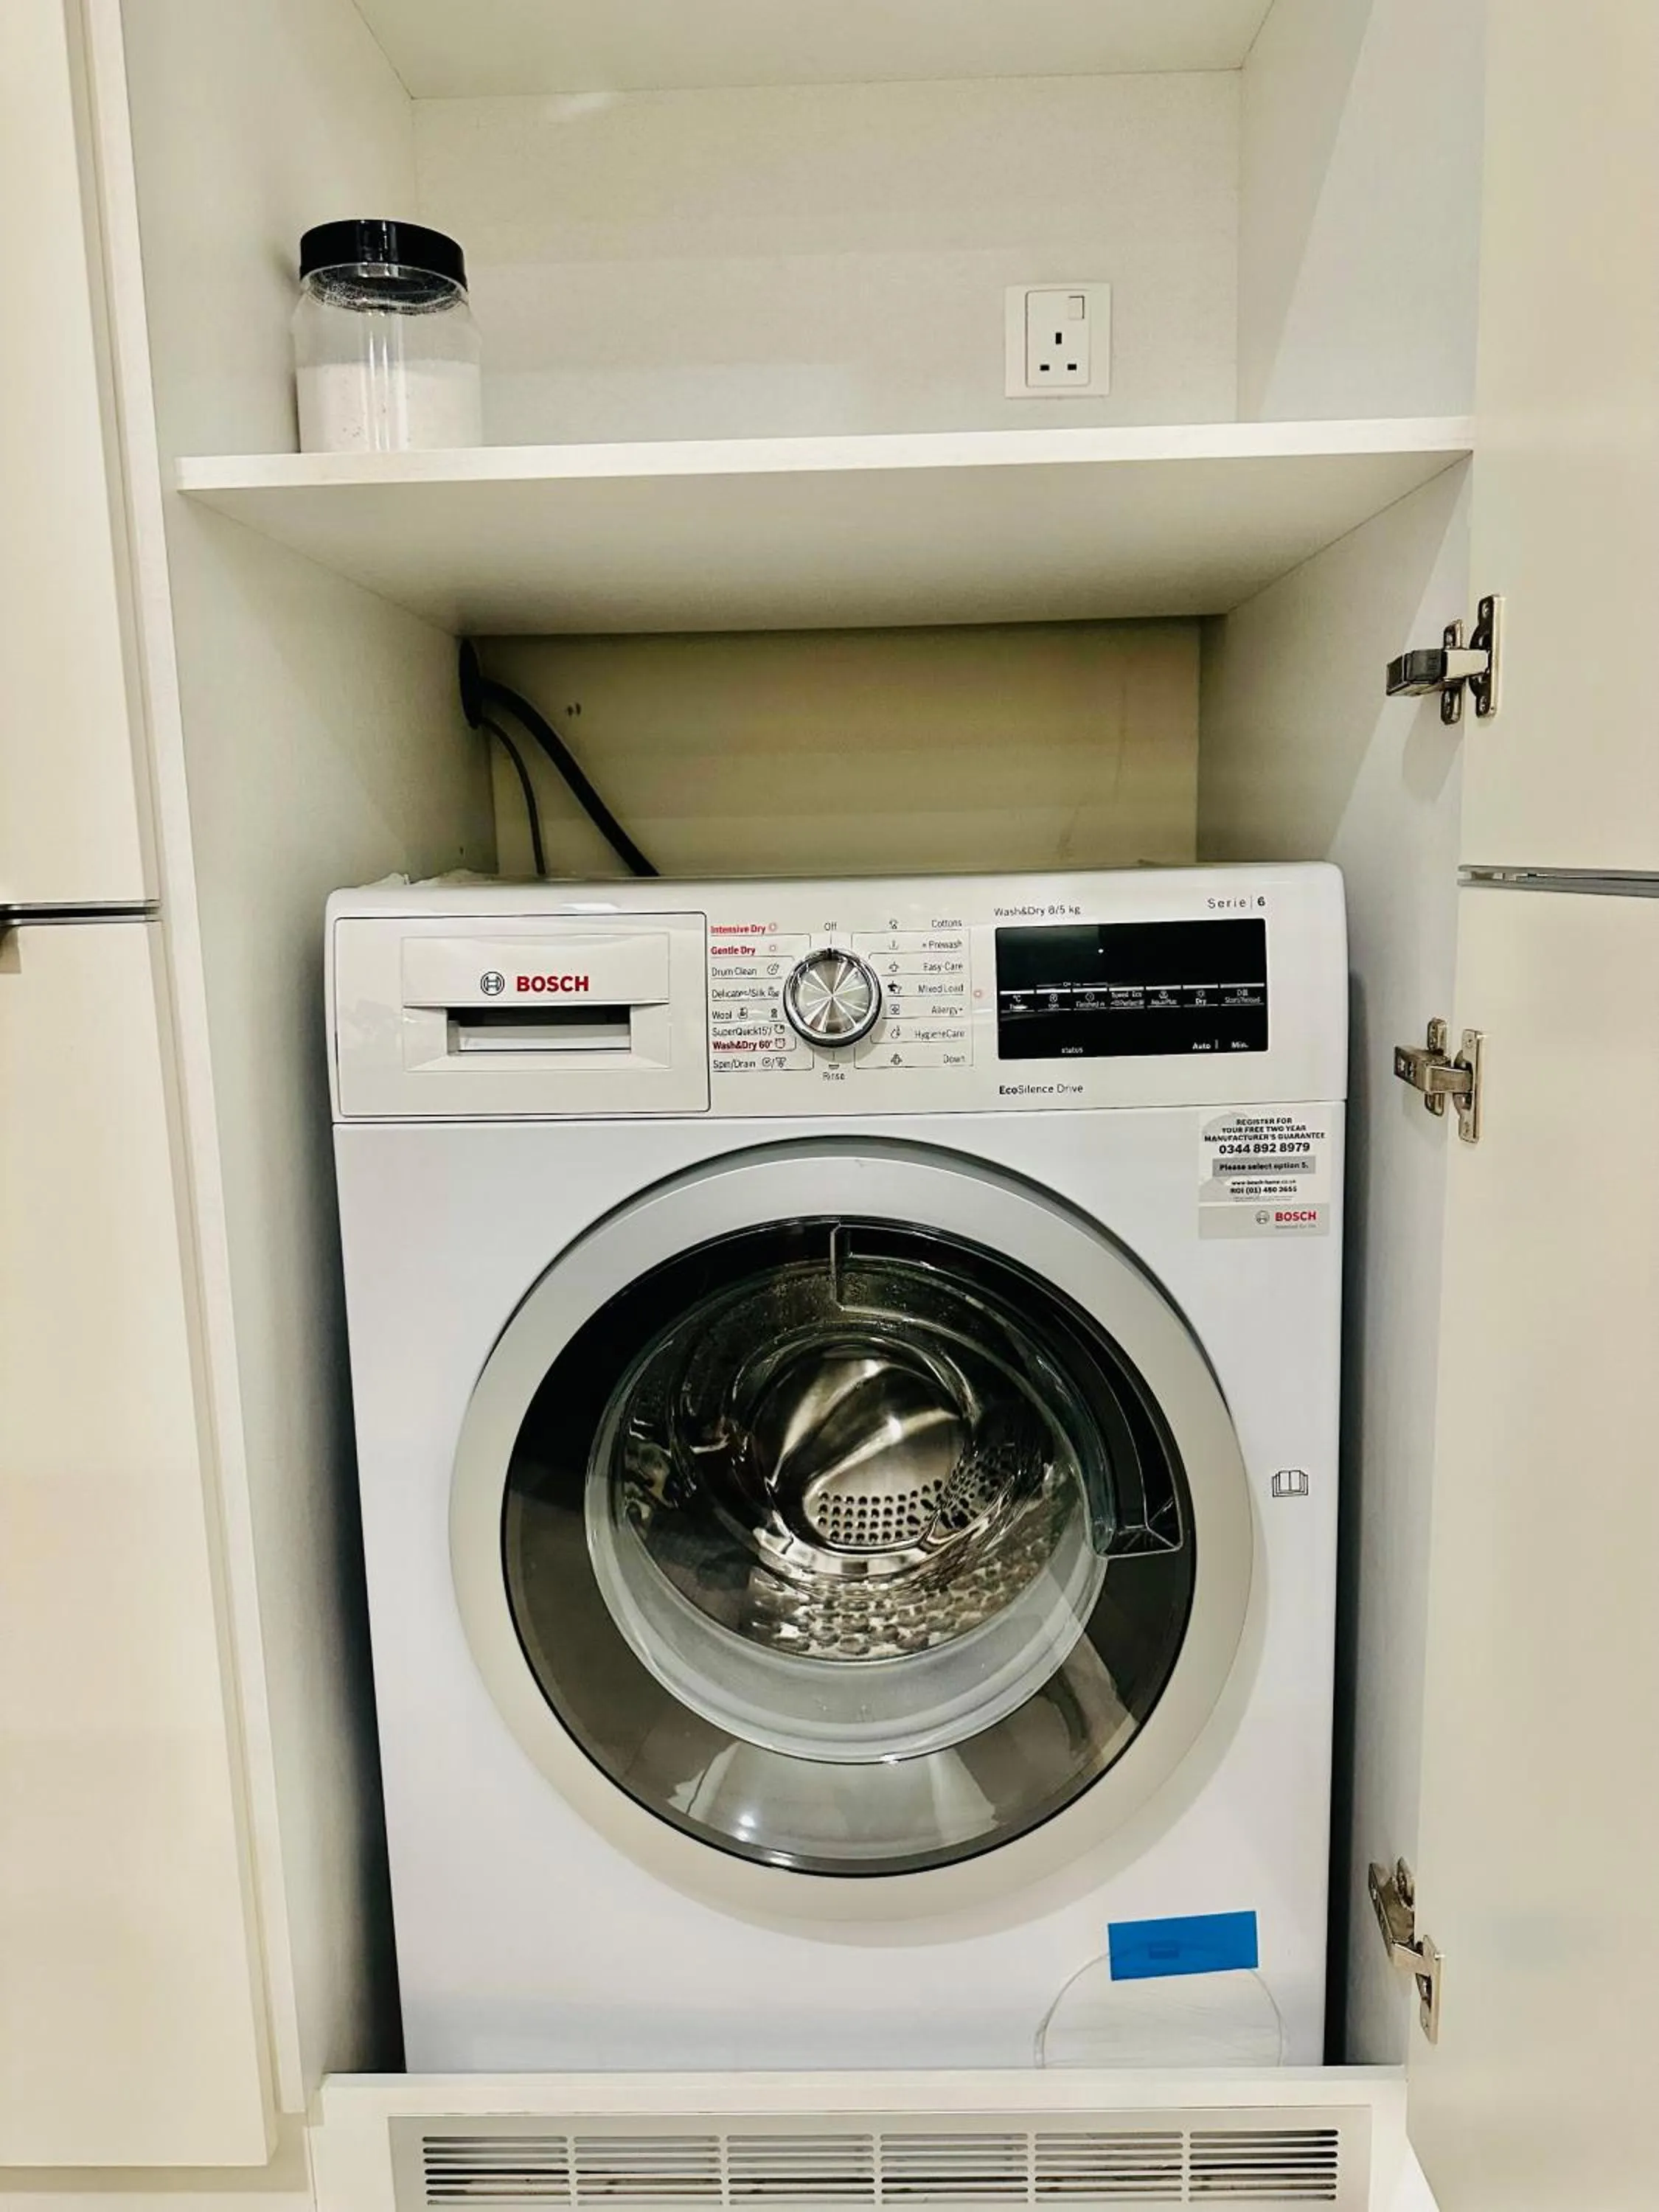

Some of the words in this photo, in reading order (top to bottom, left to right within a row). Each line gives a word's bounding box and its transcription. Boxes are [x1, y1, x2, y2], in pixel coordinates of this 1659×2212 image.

[1207, 897, 1246, 909] Serie
[1257, 896, 1266, 907] 6
[994, 907, 1046, 917] Wash&Dry
[1068, 905, 1081, 915] kg
[824, 921, 838, 931] Off
[931, 919, 962, 928] Cottons
[710, 925, 749, 934] Intensive
[751, 924, 766, 935] Dry
[711, 946, 739, 955] Gentle
[740, 945, 756, 956] Dry
[712, 967, 734, 977] Drum
[734, 967, 757, 975] Clean
[923, 962, 942, 973] Easy
[945, 961, 963, 971] Care
[517, 975, 589, 992] BOSCH
[712, 1011, 732, 1020] Wool
[712, 1040, 757, 1051] Wash&Dry
[1192, 1042, 1211, 1050] Auto
[943, 1054, 965, 1064] Down
[823, 1071, 846, 1081] Rinse
[999, 1085, 1054, 1095] EcoSilence
[1057, 1084, 1083, 1093] Drive
[1204, 1133, 1276, 1142] MANUFACTURER'S
[1278, 1131, 1326, 1140] GUARANTEE
[1219, 1144, 1251, 1154] 0344
[1253, 1143, 1276, 1153] 892
[1279, 1142, 1310, 1152] 8979
[1220, 1164, 1247, 1172] Please
[1248, 1163, 1272, 1171] select
[1273, 1161, 1300, 1171] option
[1245, 1186, 1262, 1195] (01)
[1275, 1211, 1317, 1222] BOSCH
